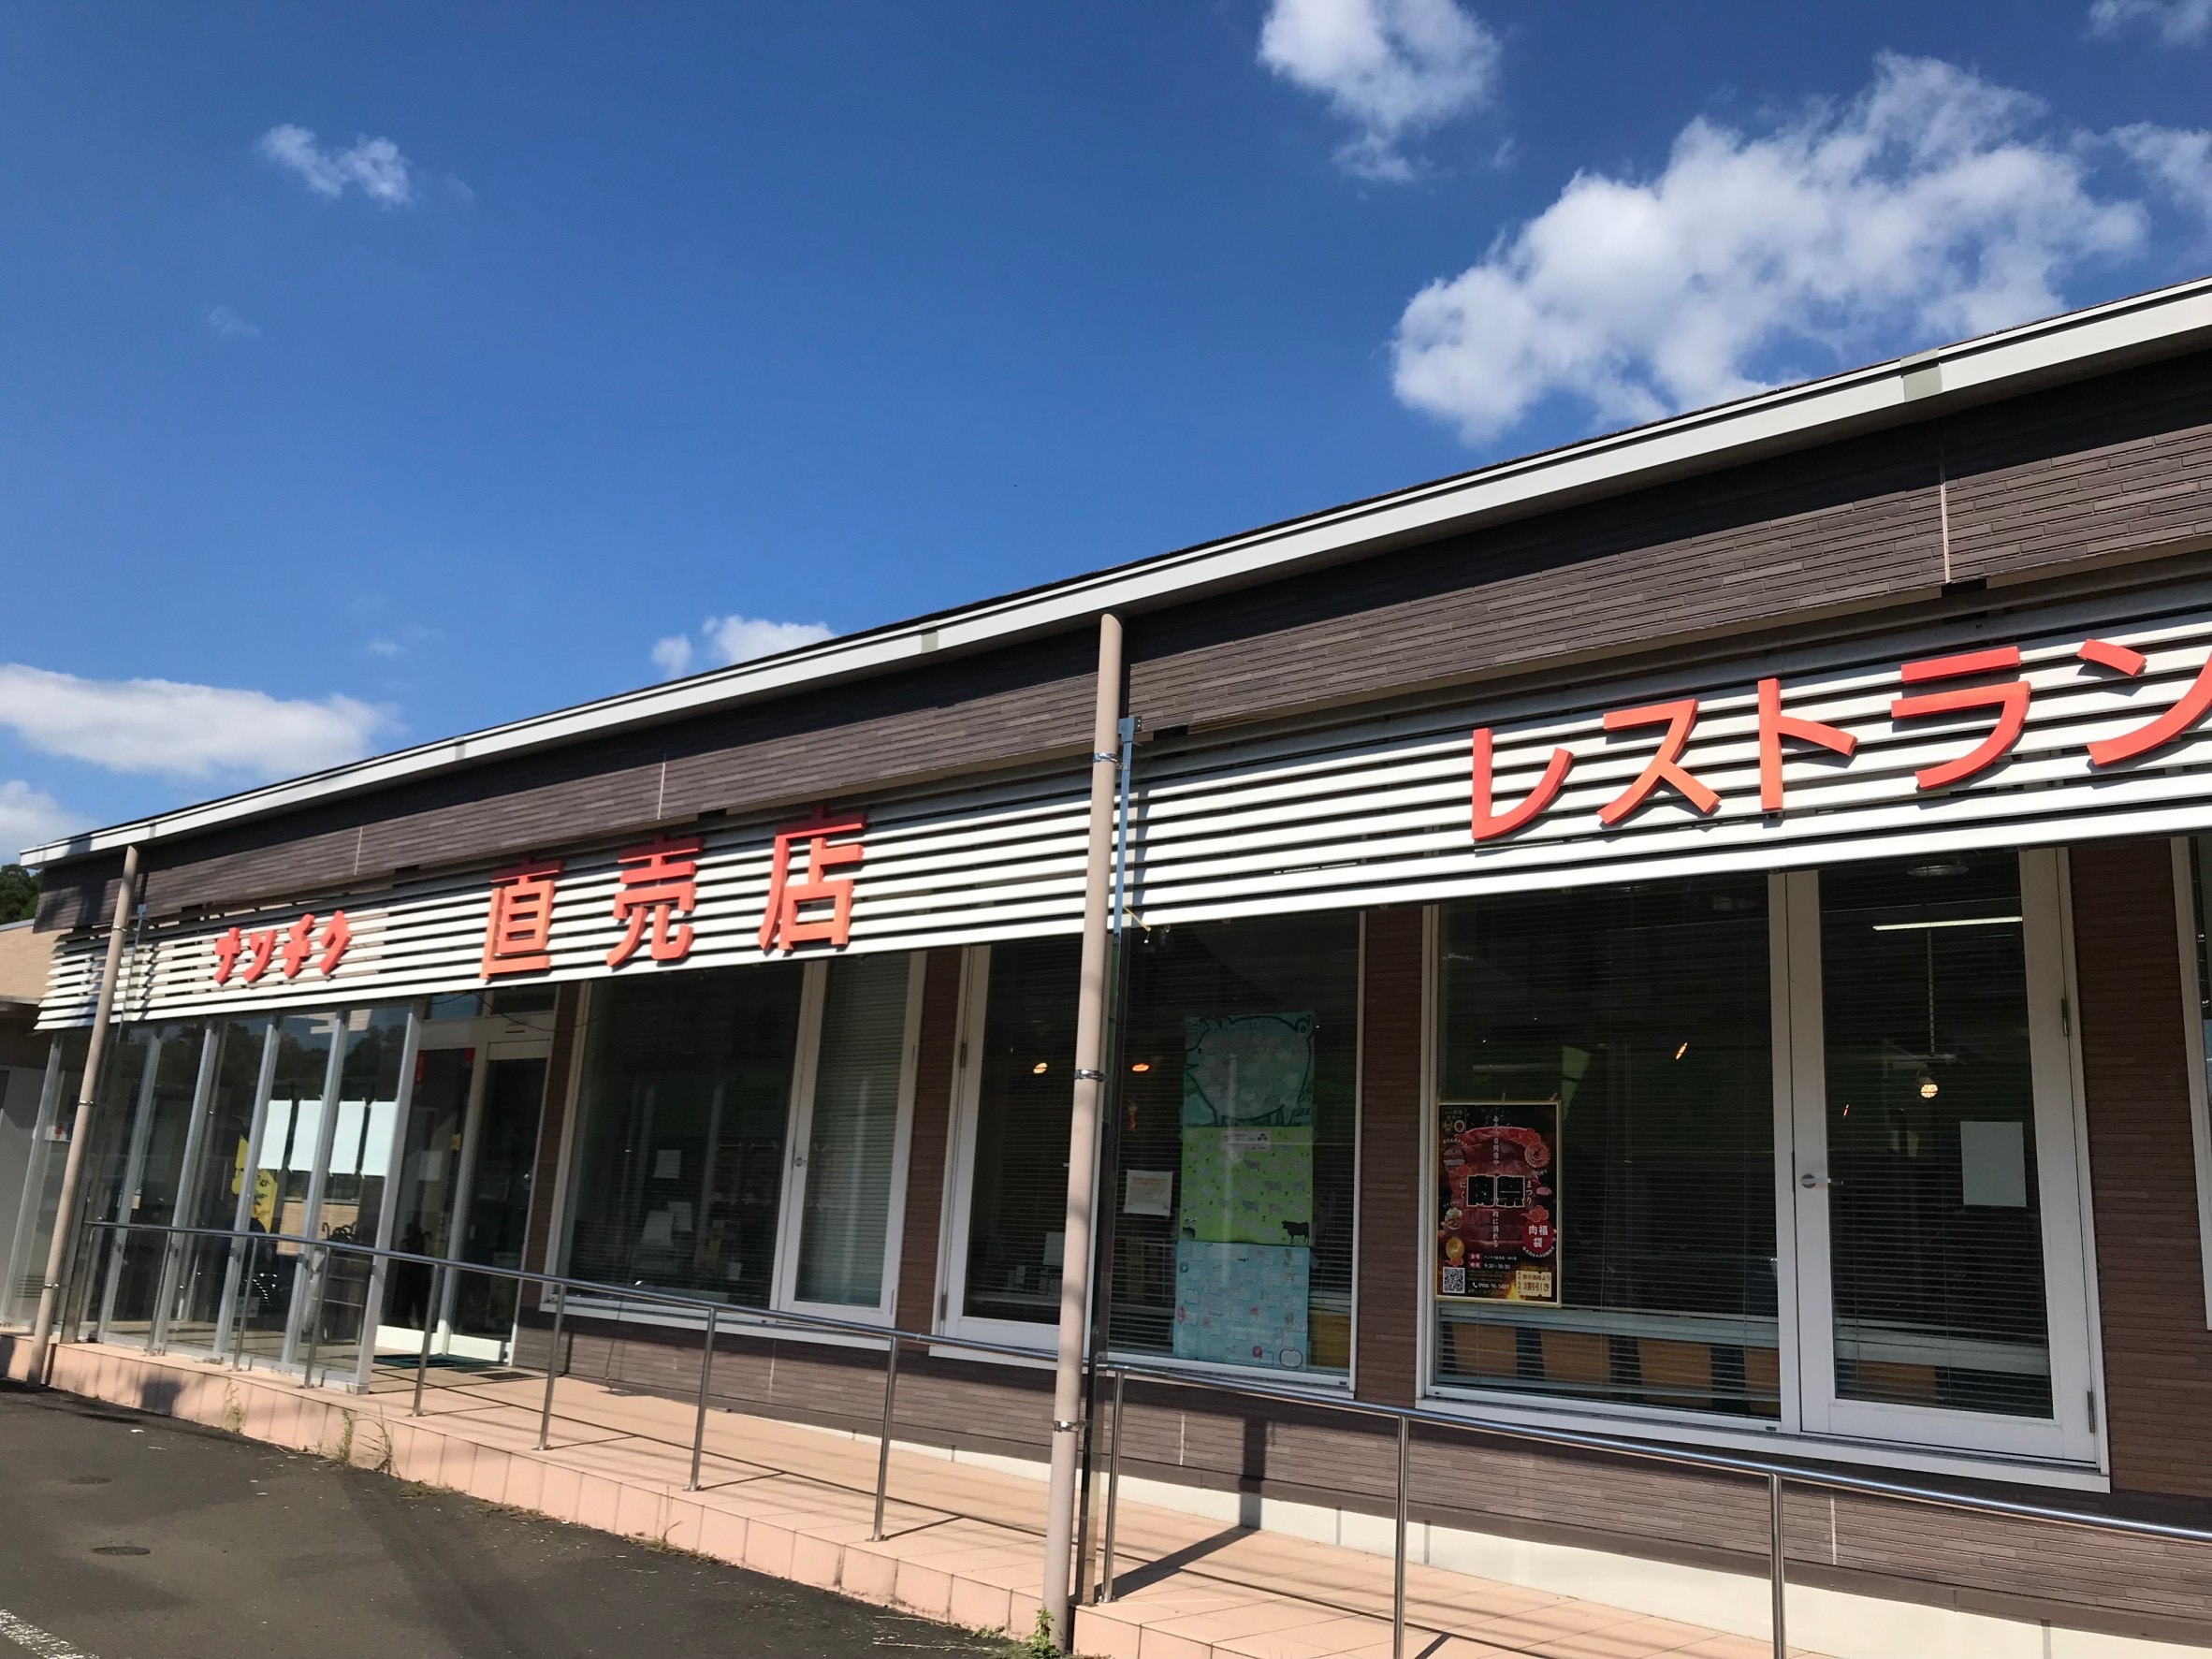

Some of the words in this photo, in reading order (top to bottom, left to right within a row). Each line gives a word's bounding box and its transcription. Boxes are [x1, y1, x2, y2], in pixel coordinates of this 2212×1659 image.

[1471, 637, 2212, 841] レストラン
[214, 909, 351, 987] ナンチク
[479, 805, 868, 982] 直売店
[1522, 1281, 1550, 1292] 3割引き
